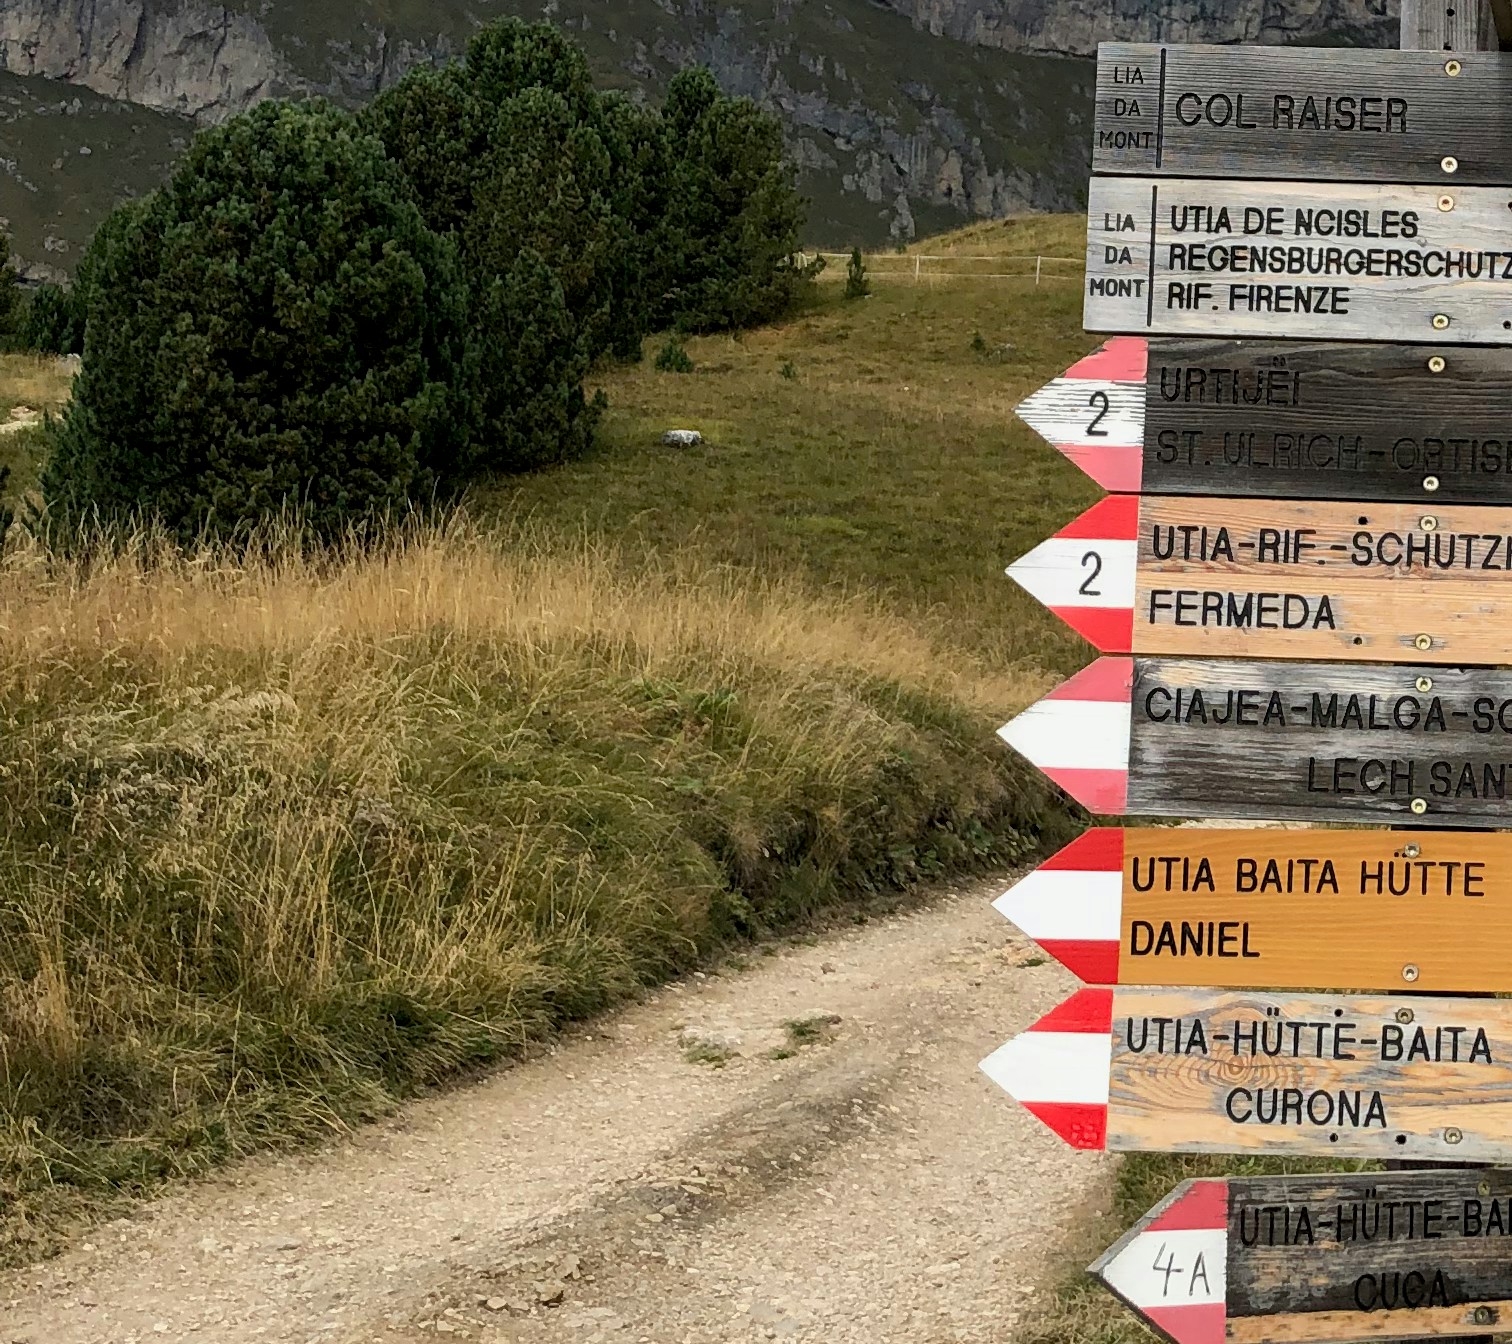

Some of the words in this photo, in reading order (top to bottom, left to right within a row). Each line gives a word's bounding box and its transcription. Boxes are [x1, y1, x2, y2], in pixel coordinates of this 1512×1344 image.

[1113, 66, 1144, 85] LIA
[1114, 98, 1141, 118] DA
[1175, 94, 1256, 130] COL
[1272, 96, 1409, 134] RAISER
[1100, 130, 1151, 151] MONT
[1104, 214, 1136, 233] LIA
[1170, 205, 1230, 235] UTIA
[1244, 208, 1284, 236] DE
[1296, 209, 1417, 238] NCISLES
[1105, 246, 1132, 266] DA
[1090, 277, 1142, 298] MONT
[1167, 284, 1218, 312] RIF.
[1230, 286, 1349, 316] FIRENZE
[1086, 391, 1110, 436] 2
[1079, 550, 1102, 597] 2
[1149, 590, 1336, 631] FERMEDA
[1308, 758, 1416, 795] LECH
[1132, 856, 1215, 893] UTIA
[1237, 858, 1339, 895] BAITA
[1360, 852, 1486, 897] HÜTTE
[1131, 920, 1260, 958] DANIEL
[1225, 1087, 1386, 1129] CURONA
